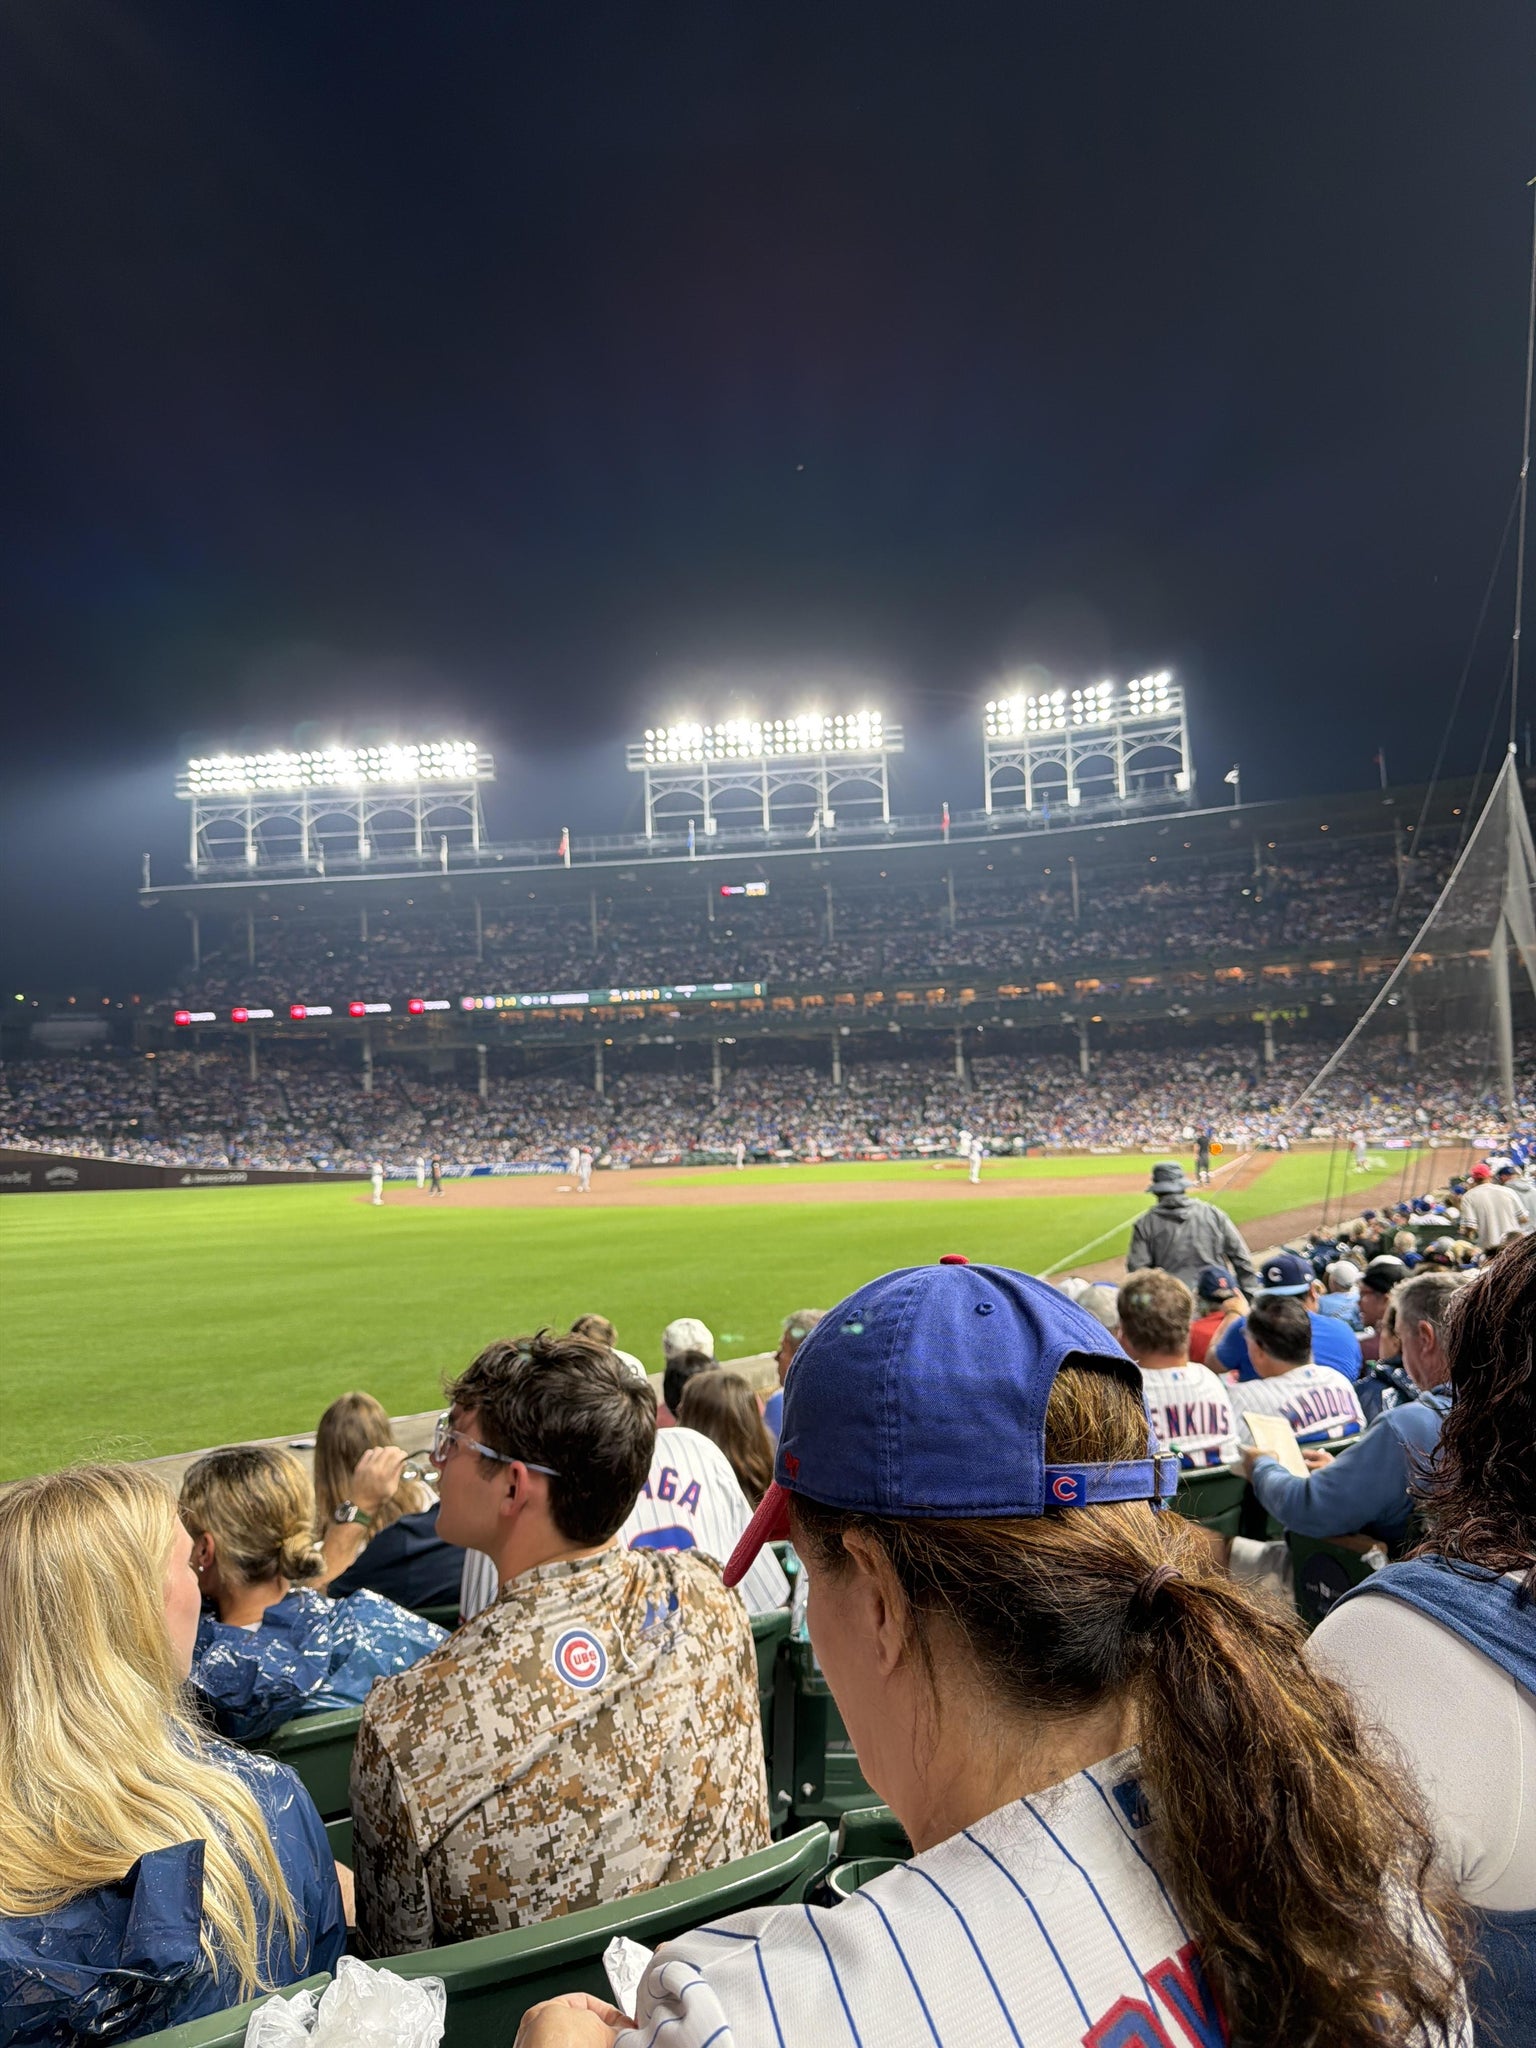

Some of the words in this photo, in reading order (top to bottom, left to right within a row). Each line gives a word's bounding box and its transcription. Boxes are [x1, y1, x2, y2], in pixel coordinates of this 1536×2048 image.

[1150, 1401, 1229, 1440] ENKINS
[1052, 1476, 1078, 1501] C
[564, 1640, 598, 1677] CUBS
